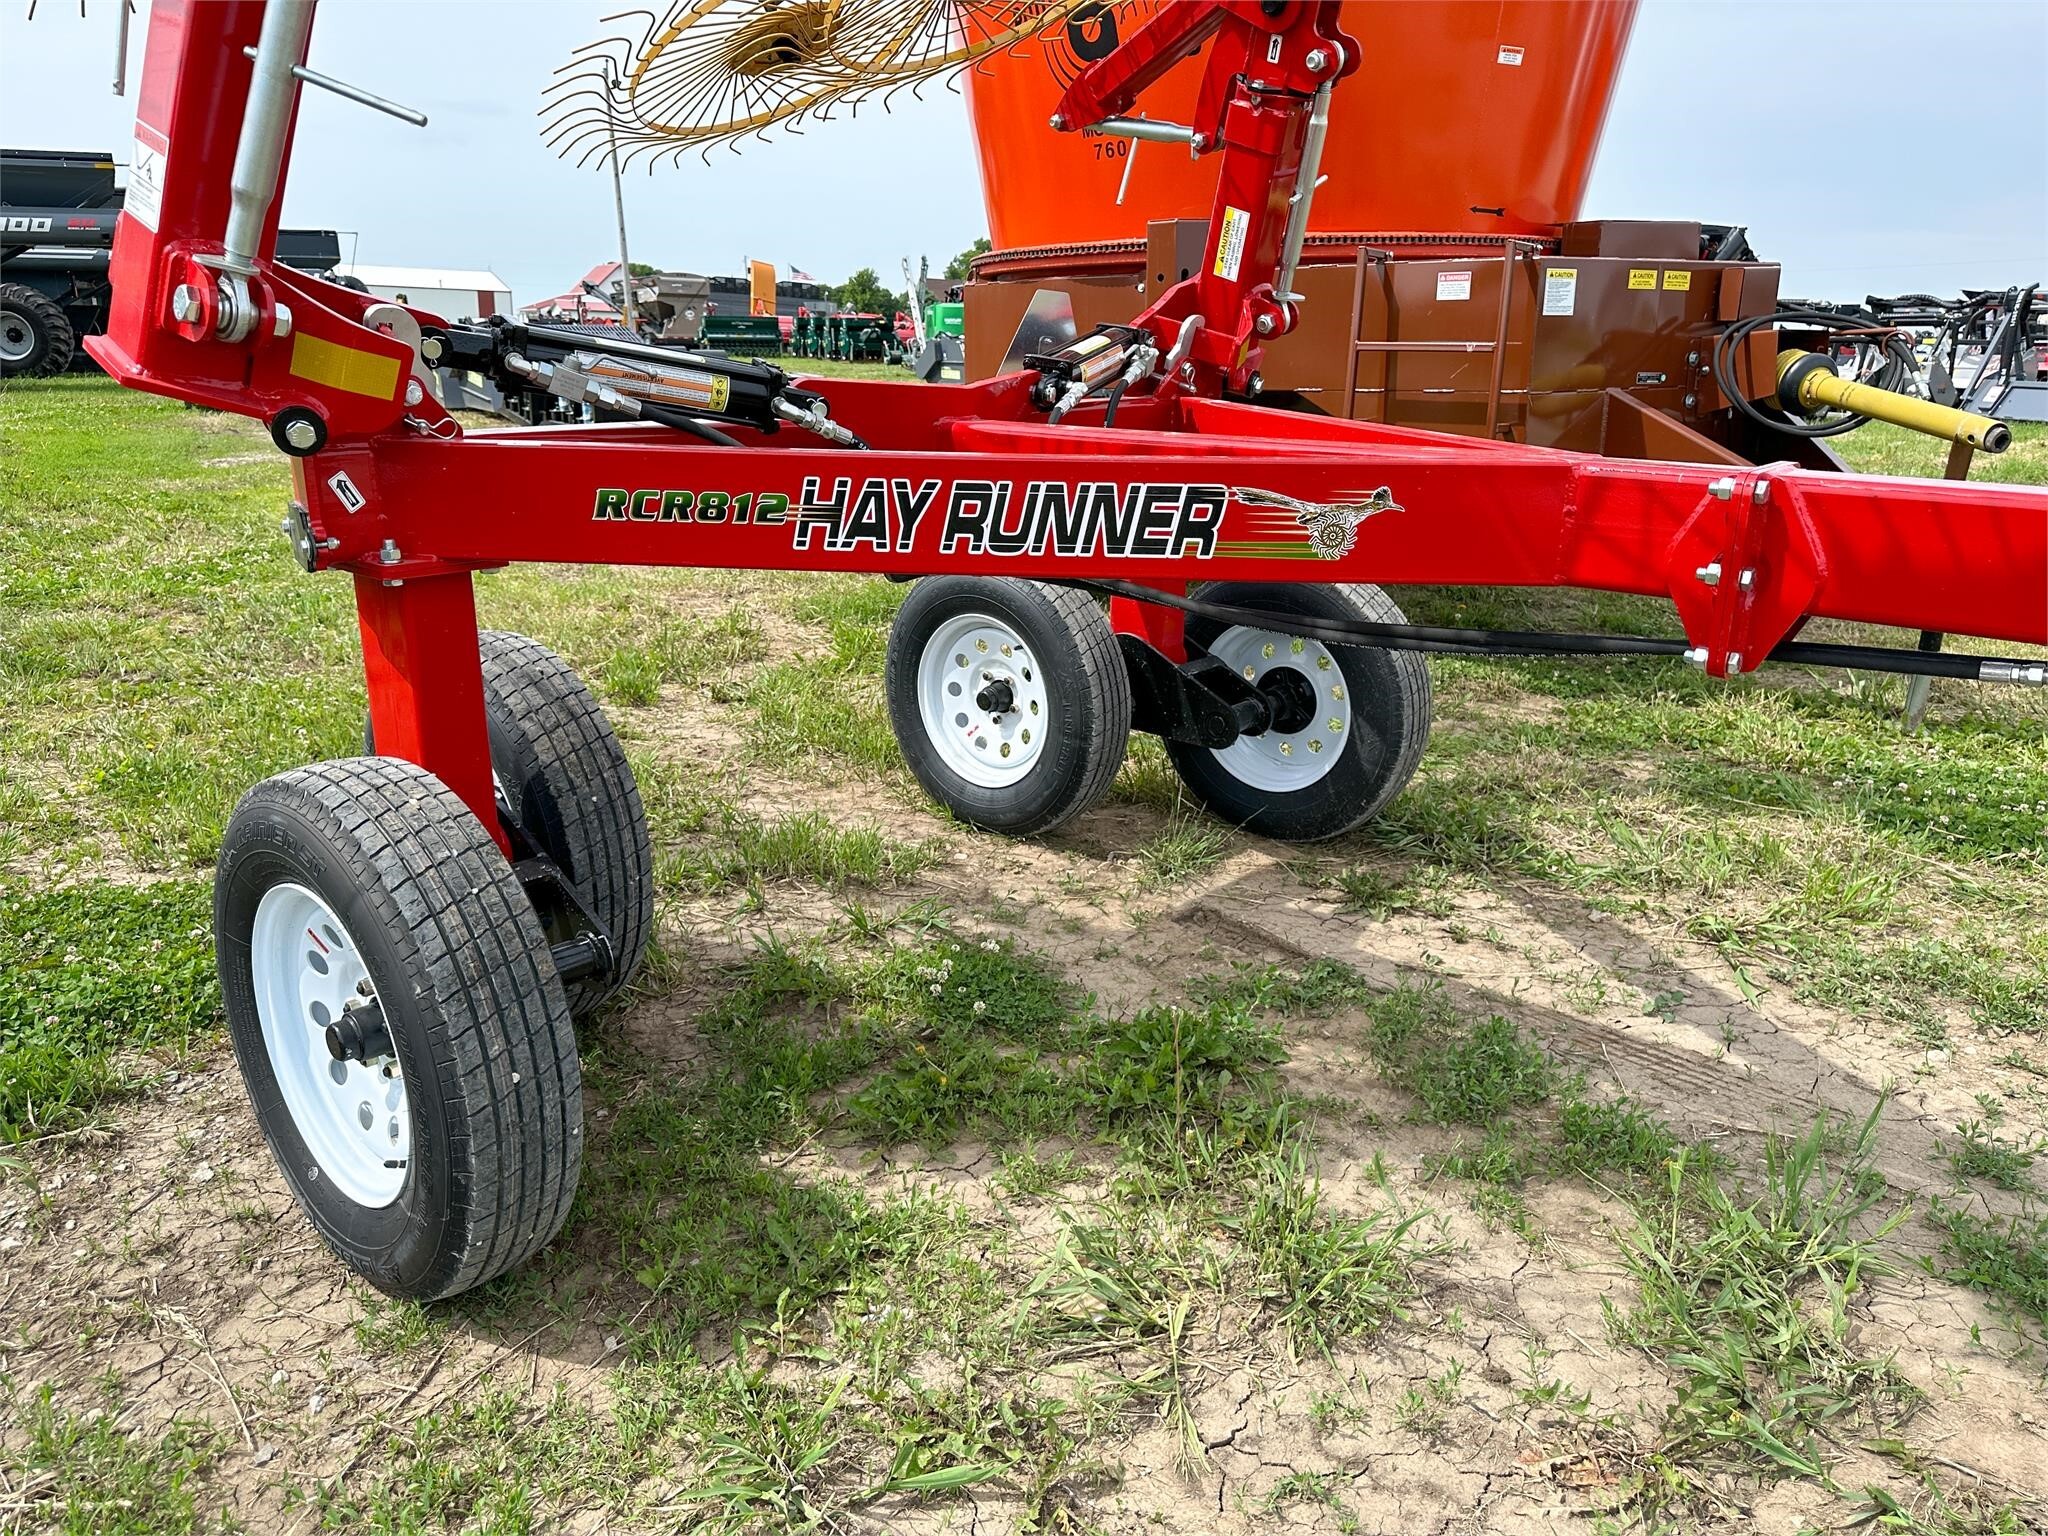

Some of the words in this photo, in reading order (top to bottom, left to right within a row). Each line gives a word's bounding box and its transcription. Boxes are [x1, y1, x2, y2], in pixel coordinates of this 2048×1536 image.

[1094, 140, 1127, 160] 760
[1220, 220, 1231, 255] CAUTION
[592, 488, 790, 525] RCR812
[792, 476, 942, 553] HAY
[939, 479, 1228, 559] RUNNER
